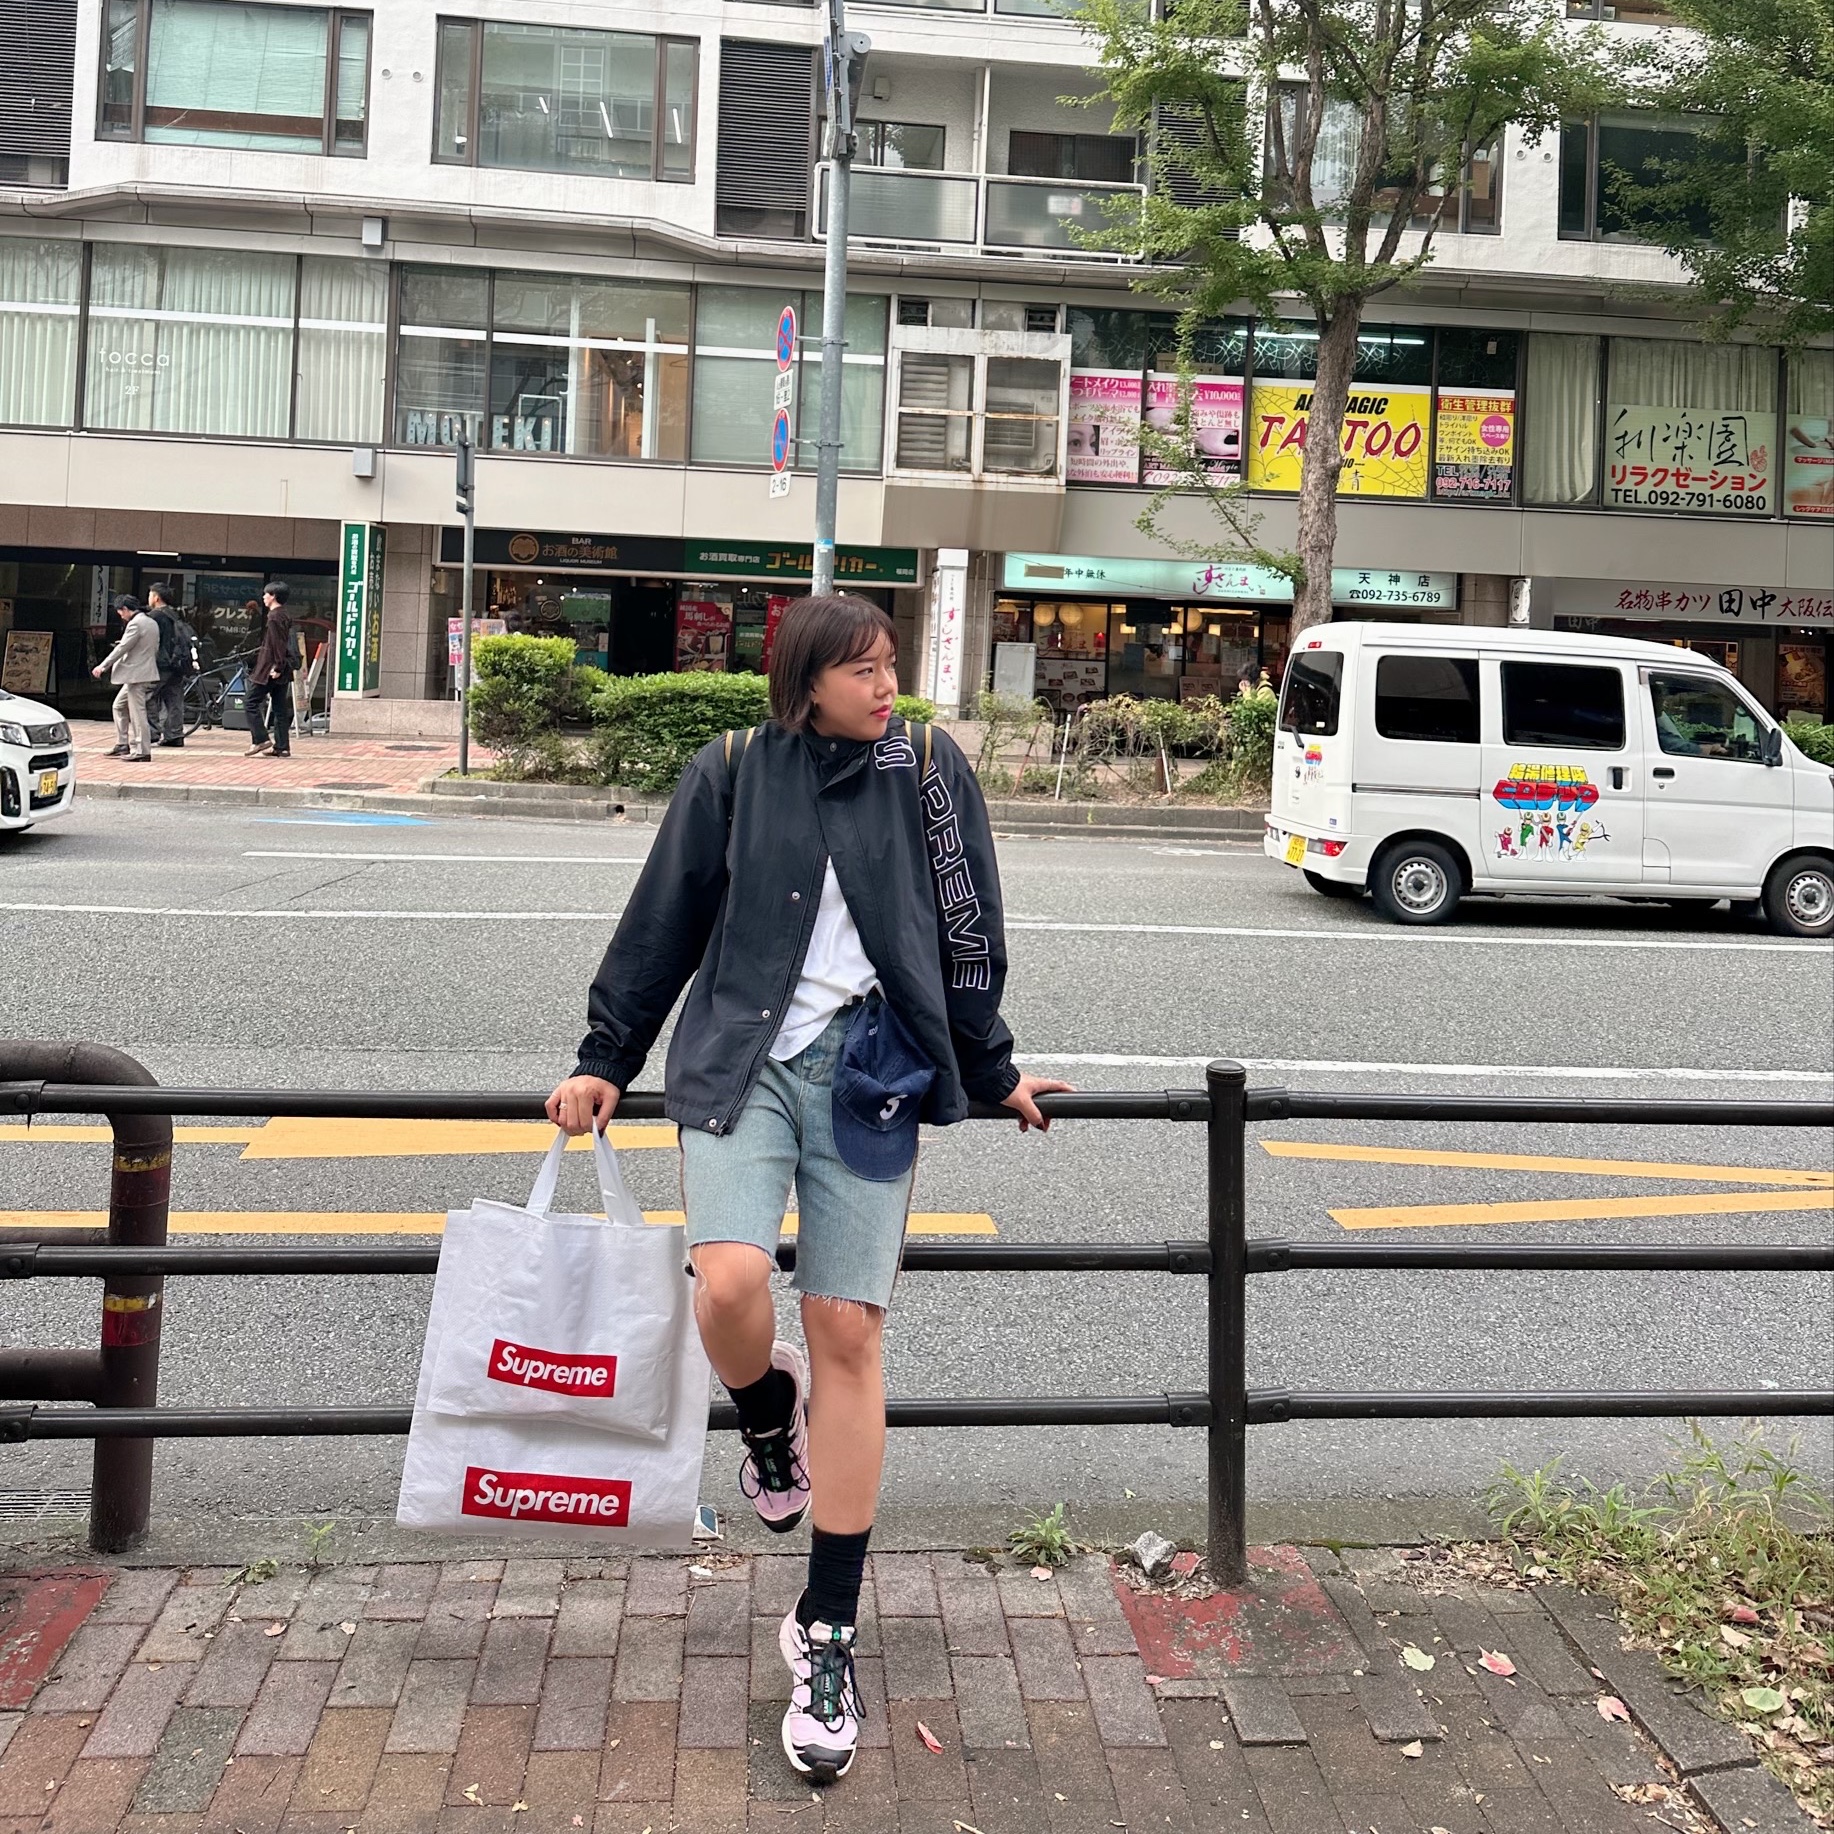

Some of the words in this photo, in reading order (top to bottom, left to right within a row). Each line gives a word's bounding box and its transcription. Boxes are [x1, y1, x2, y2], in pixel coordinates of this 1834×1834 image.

[99, 347, 170, 366] tocca
[124, 385, 140, 395] 2F
[1346, 396, 1389, 415] AGIC
[1440, 399, 1512, 412] 衛生管理抜群
[1259, 415, 1422, 462] TATOO
[1436, 465, 1459, 477] TEL
[1610, 463, 1768, 492] リラクゼーション
[772, 477, 787, 494] 2-16
[1436, 477, 1512, 491] 092-716-7117
[1611, 487, 1767, 511] TEL.092-791-6080
[571, 537, 592, 545] BAR
[542, 544, 618, 561] お酒の美術館
[766, 551, 878, 573] ゴールリカー
[1064, 567, 1107, 580] 年中無休
[1361, 589, 1441, 604] 092-735-6789
[873, 736, 991, 991] SPREME
[497, 1345, 608, 1384] Supreme
[473, 1473, 620, 1517] Supreme
